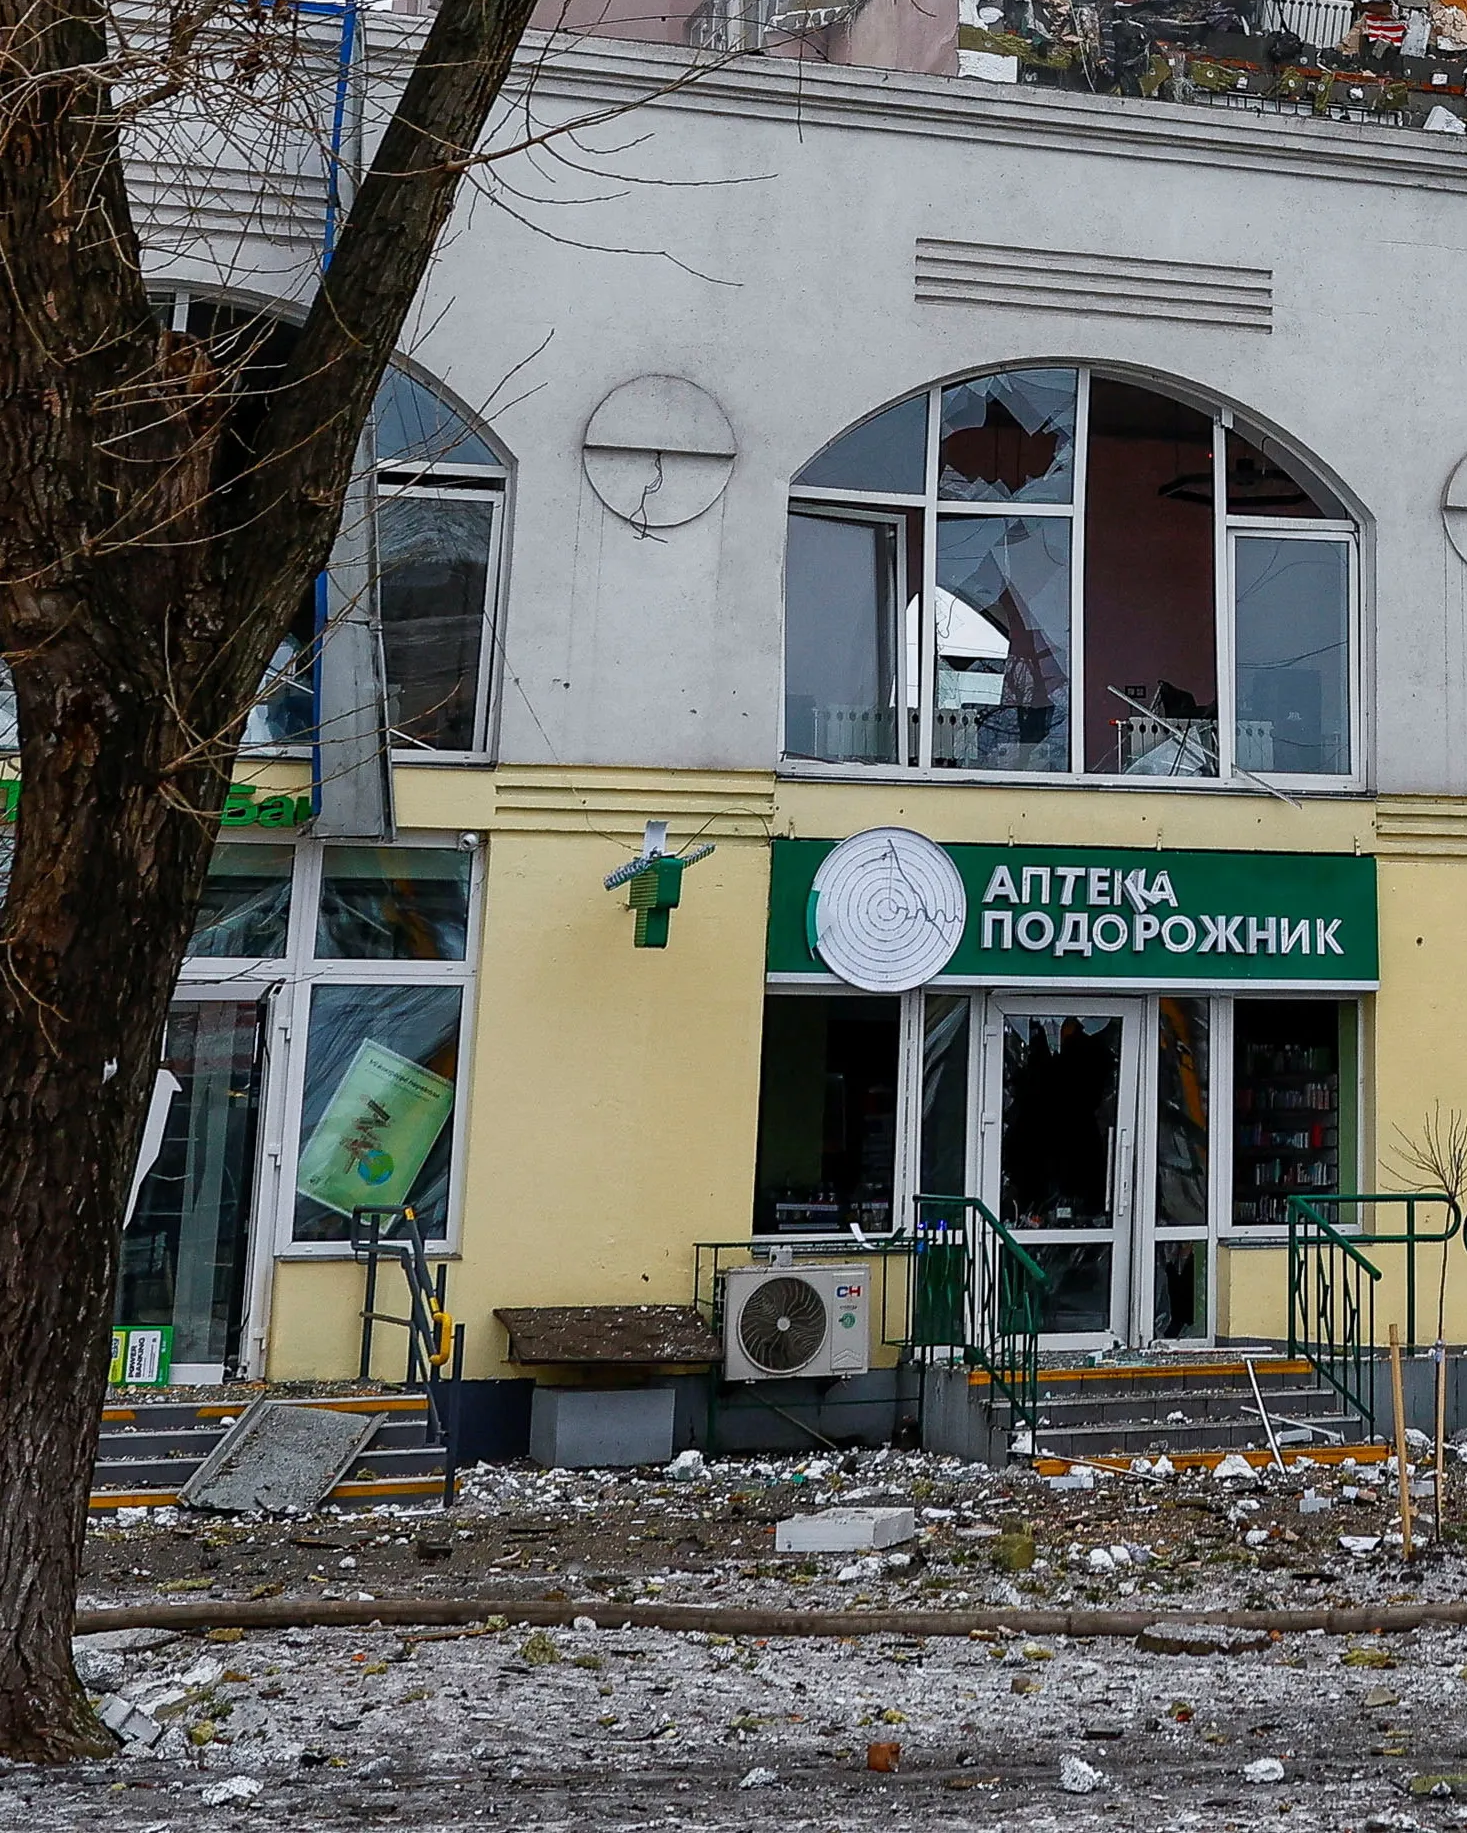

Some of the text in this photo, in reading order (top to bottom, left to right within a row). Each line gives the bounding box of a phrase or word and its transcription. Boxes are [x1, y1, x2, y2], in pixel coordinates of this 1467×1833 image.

[981, 910, 1345, 958] ПОДОРОЖНИК
[836, 1285, 861, 1298] CH
[127, 1345, 138, 1378] POWER
[134, 1336, 146, 1378] BANKING
